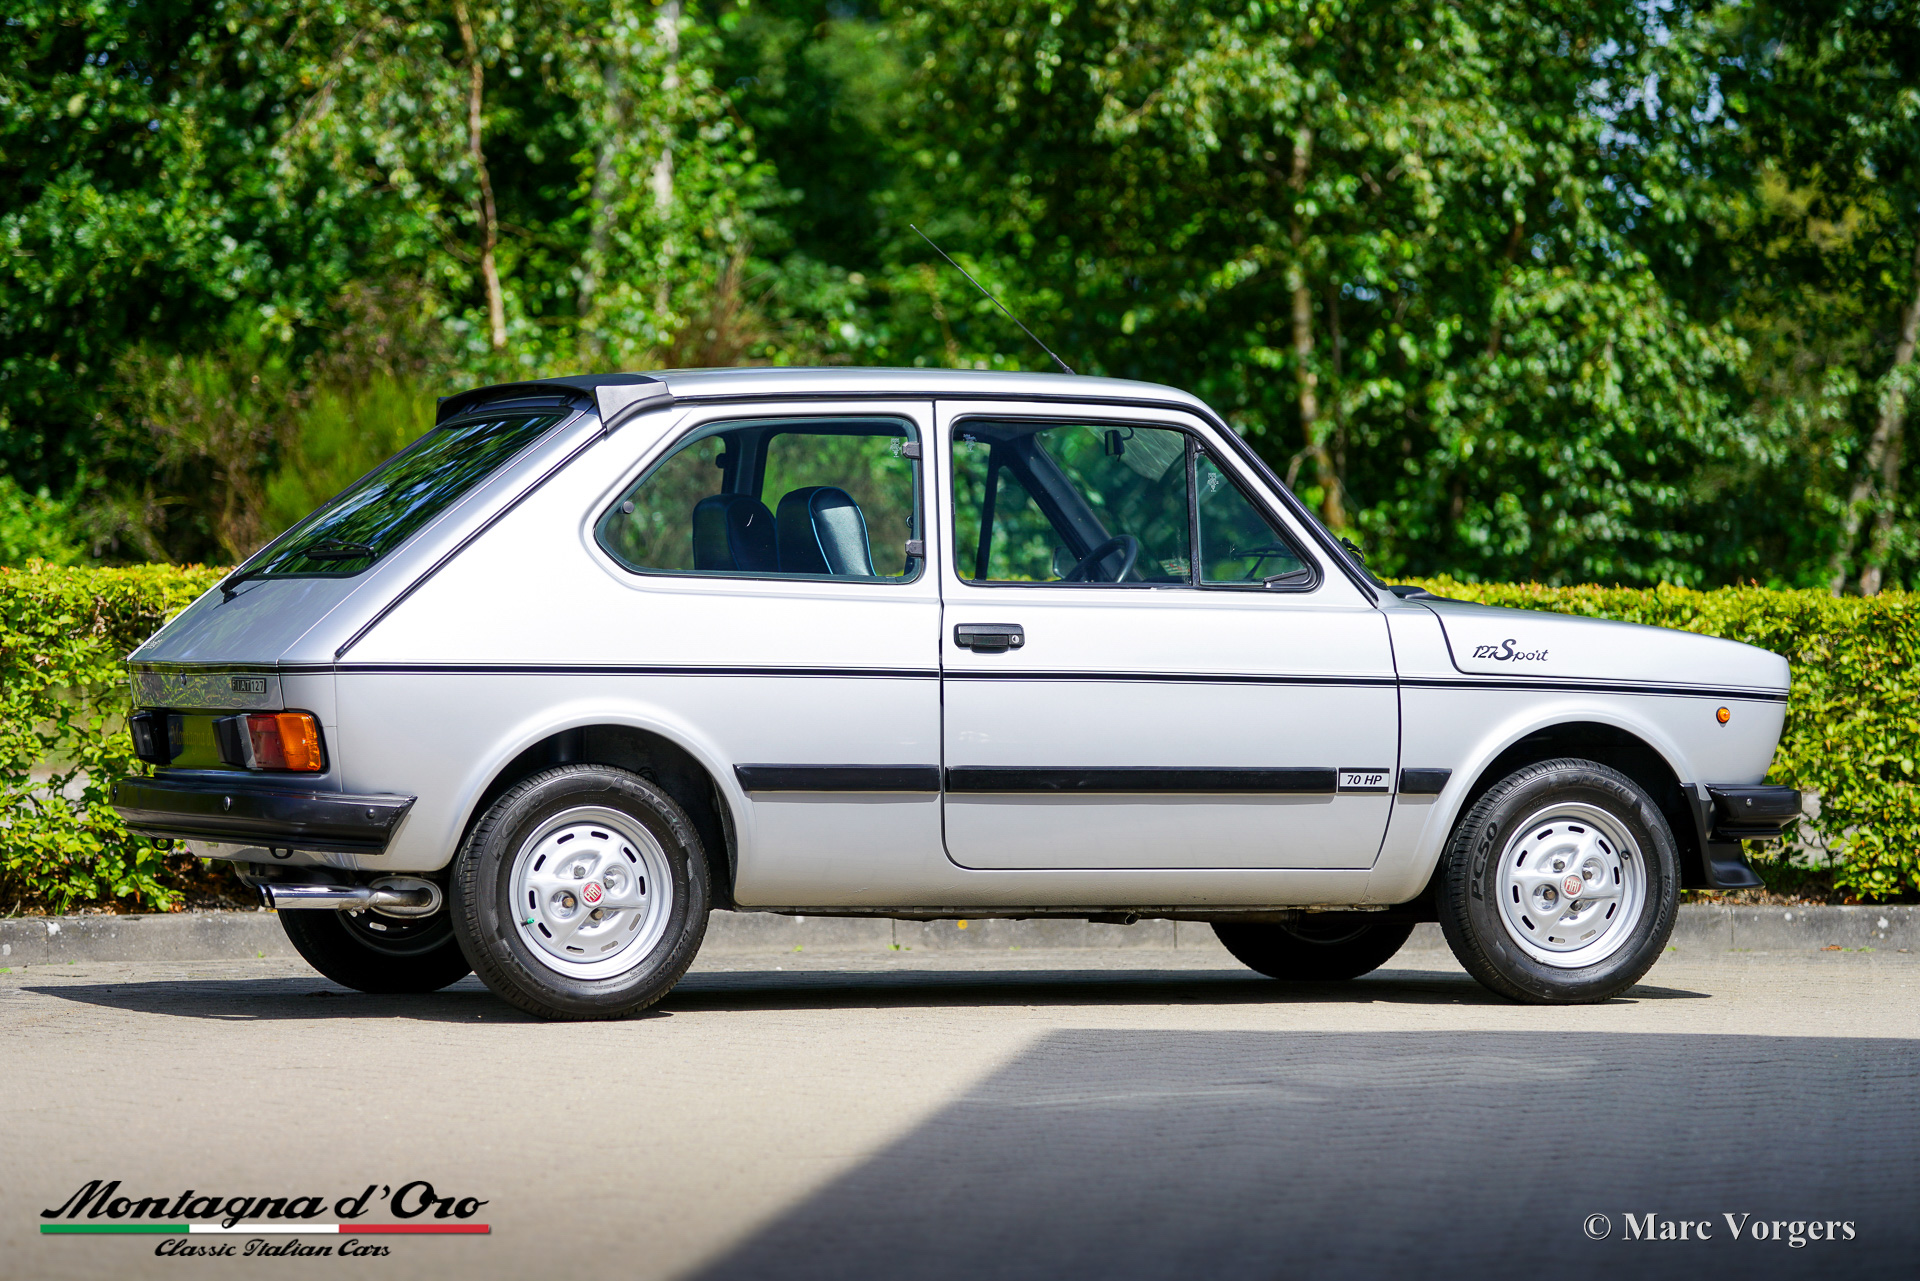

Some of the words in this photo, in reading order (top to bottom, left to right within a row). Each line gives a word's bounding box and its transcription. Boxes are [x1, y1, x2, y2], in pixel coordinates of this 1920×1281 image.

[232, 679, 250, 691] FIAT
[251, 680, 264, 692] 127
[1347, 775, 1361, 785] 70
[1364, 775, 1382, 785] HP
[1471, 822, 1498, 902] PC50
[583, 884, 602, 902] FIAT
[1564, 879, 1582, 895] FIAT
[1650, 873, 1672, 943] 155/70R13
